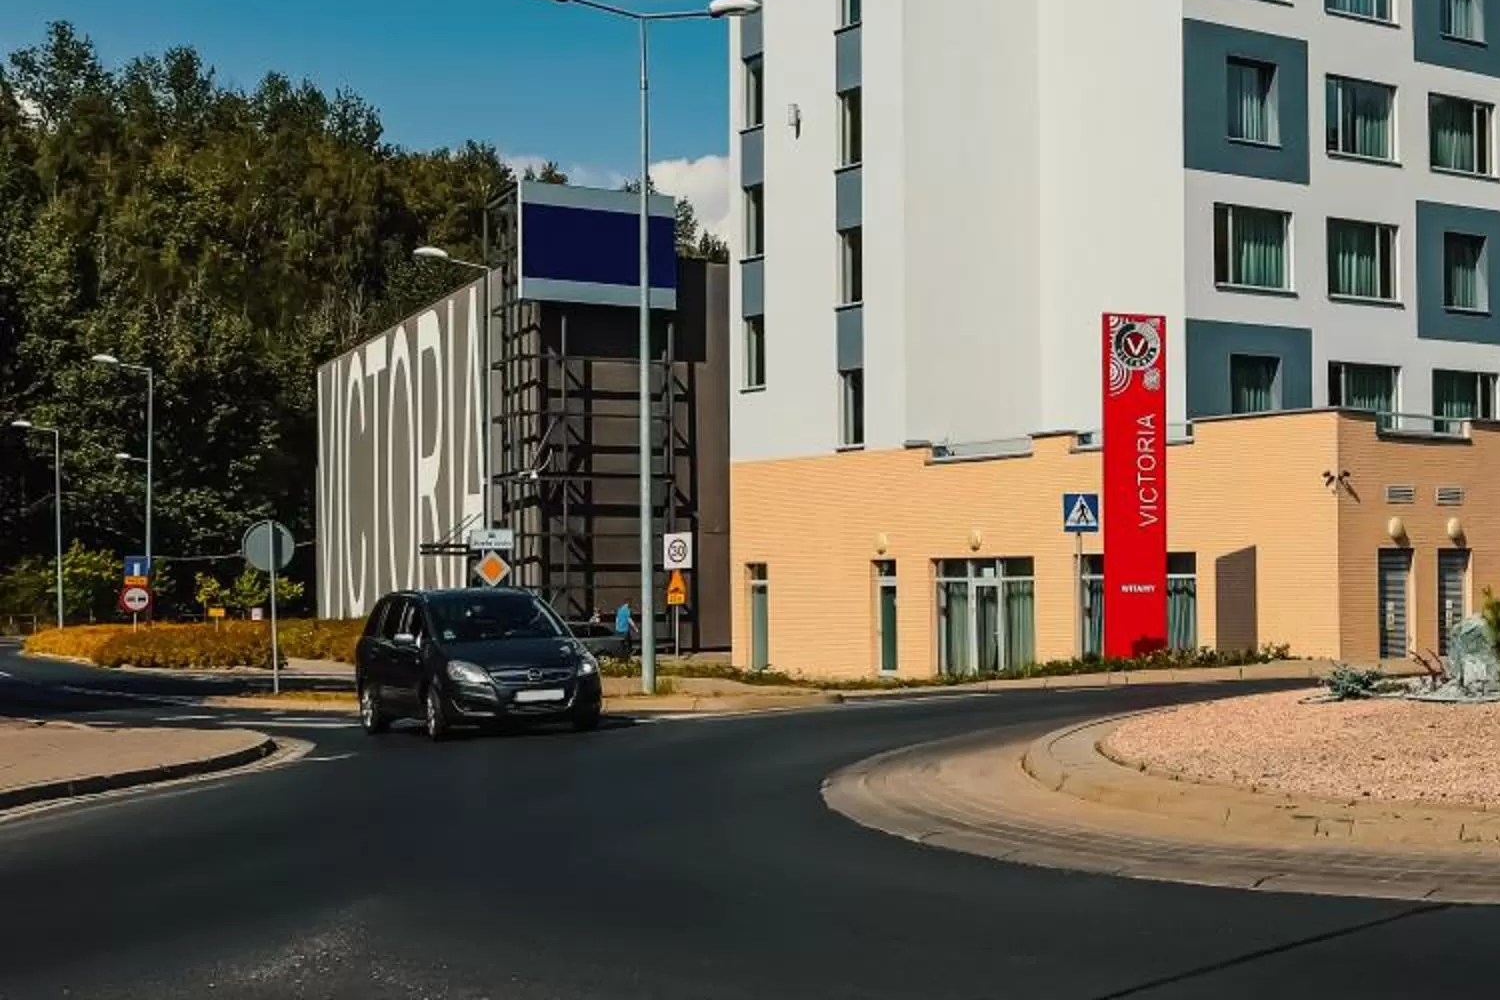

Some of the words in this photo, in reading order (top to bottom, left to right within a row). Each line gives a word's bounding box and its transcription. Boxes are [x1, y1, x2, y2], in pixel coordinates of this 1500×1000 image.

[317, 287, 484, 619] VICTORIA
[1136, 413, 1159, 527] VICTORIA
[671, 545, 685, 557] 30
